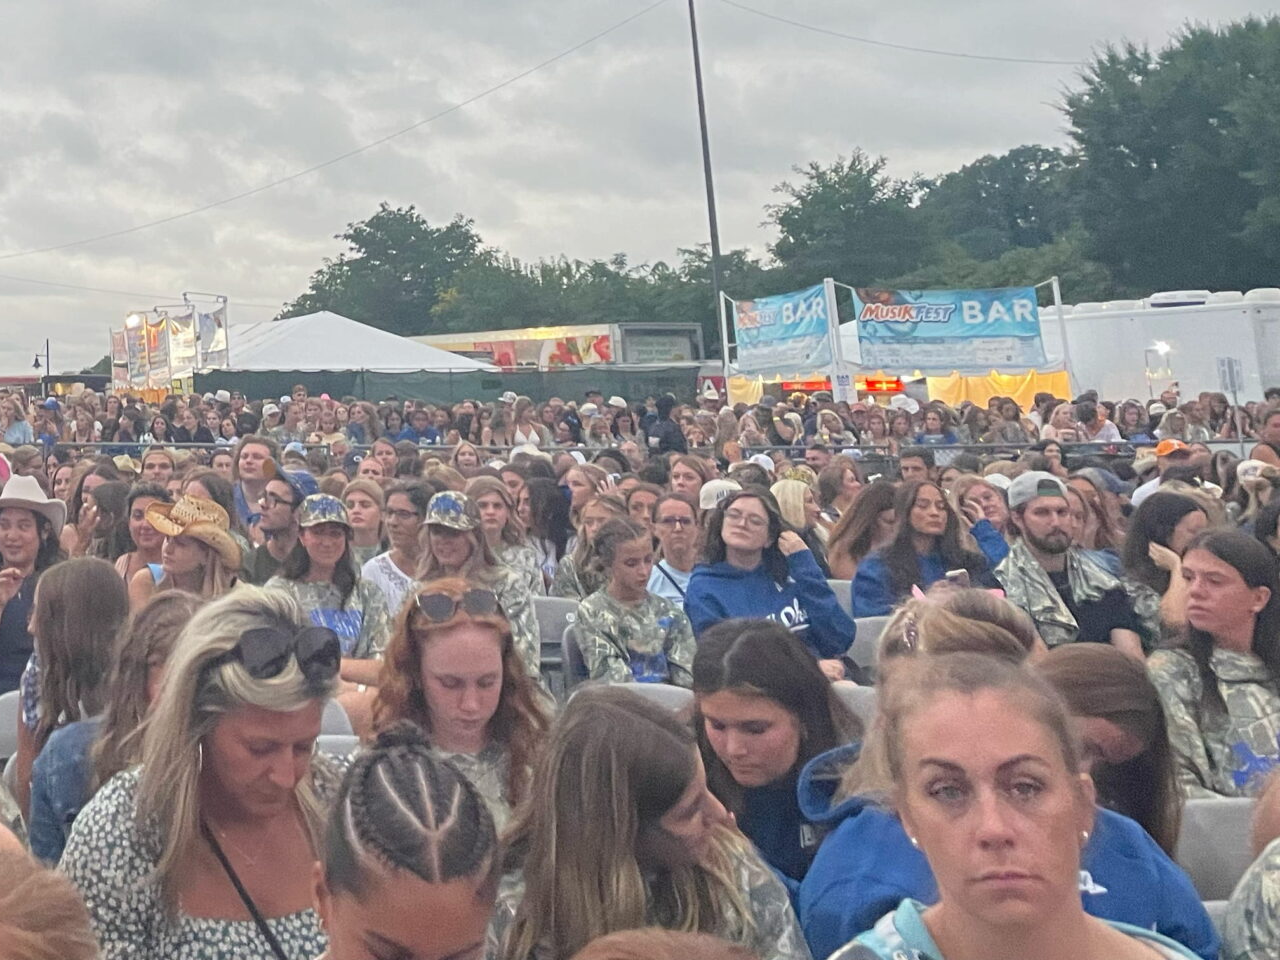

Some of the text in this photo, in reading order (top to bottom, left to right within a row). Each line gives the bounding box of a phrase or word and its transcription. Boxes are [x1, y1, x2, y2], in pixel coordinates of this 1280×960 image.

[782, 295, 826, 325] BAR
[859, 297, 1037, 324] MUSIKFEST BAR
